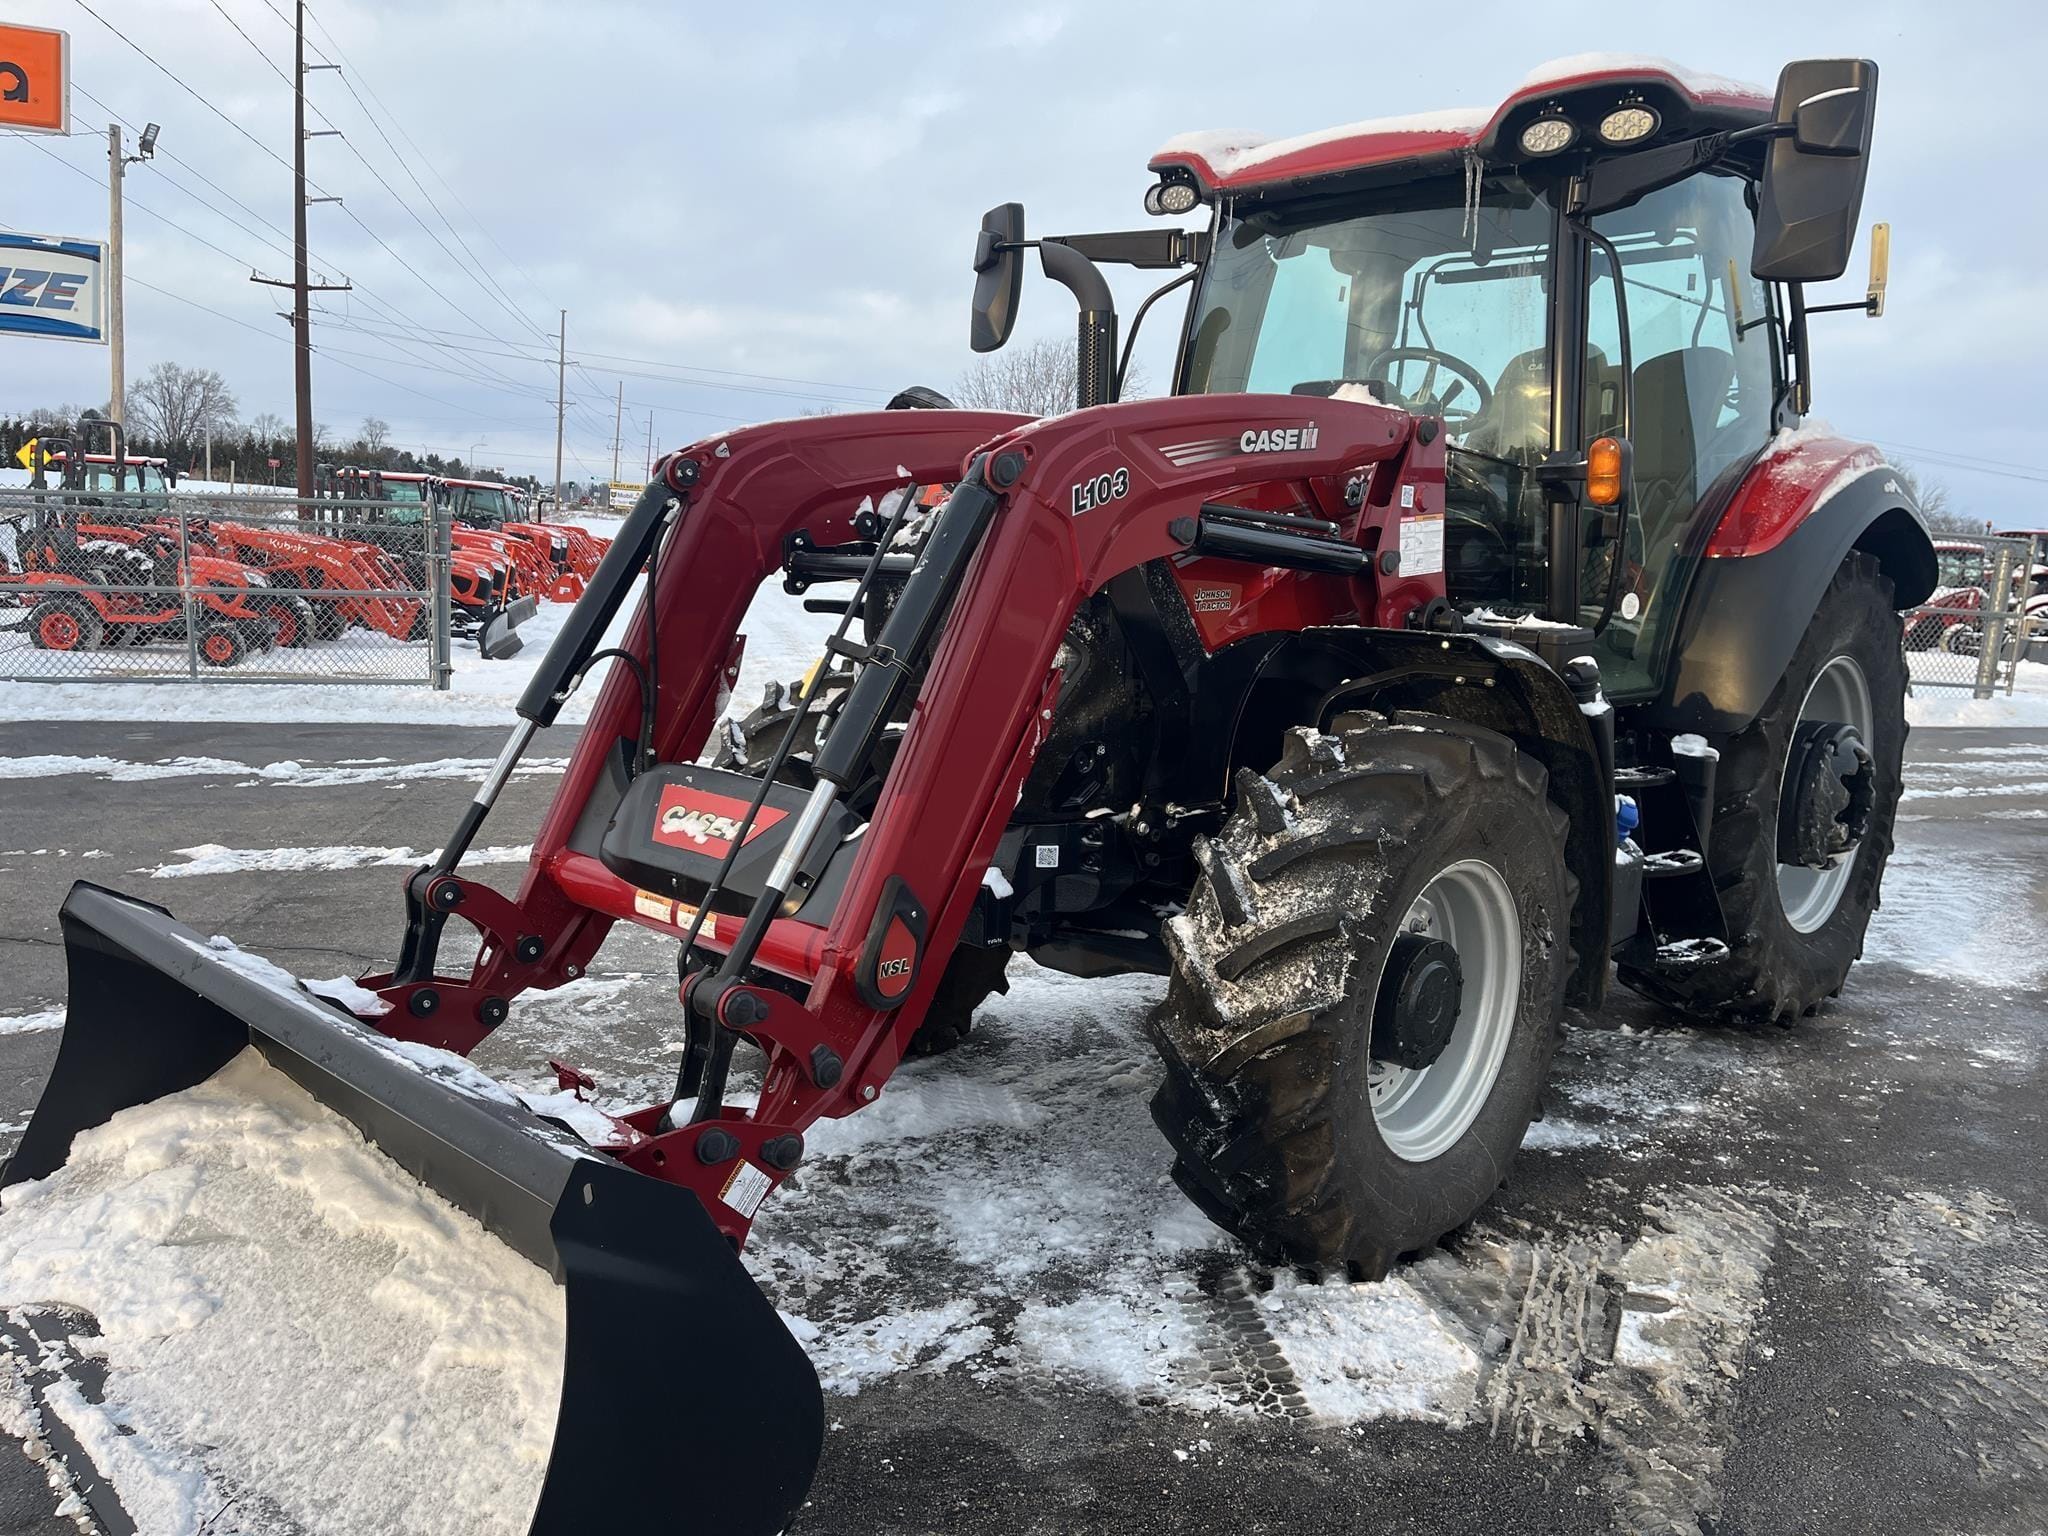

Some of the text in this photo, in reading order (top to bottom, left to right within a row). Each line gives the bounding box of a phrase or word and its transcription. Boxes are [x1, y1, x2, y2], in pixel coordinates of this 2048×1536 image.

[1072, 467, 1129, 516] L103
[269, 538, 309, 554] Kubota
[1194, 588, 1232, 600] JOHNSON
[1195, 599, 1231, 612] TRACTOR
[880, 958, 910, 978] NSL
